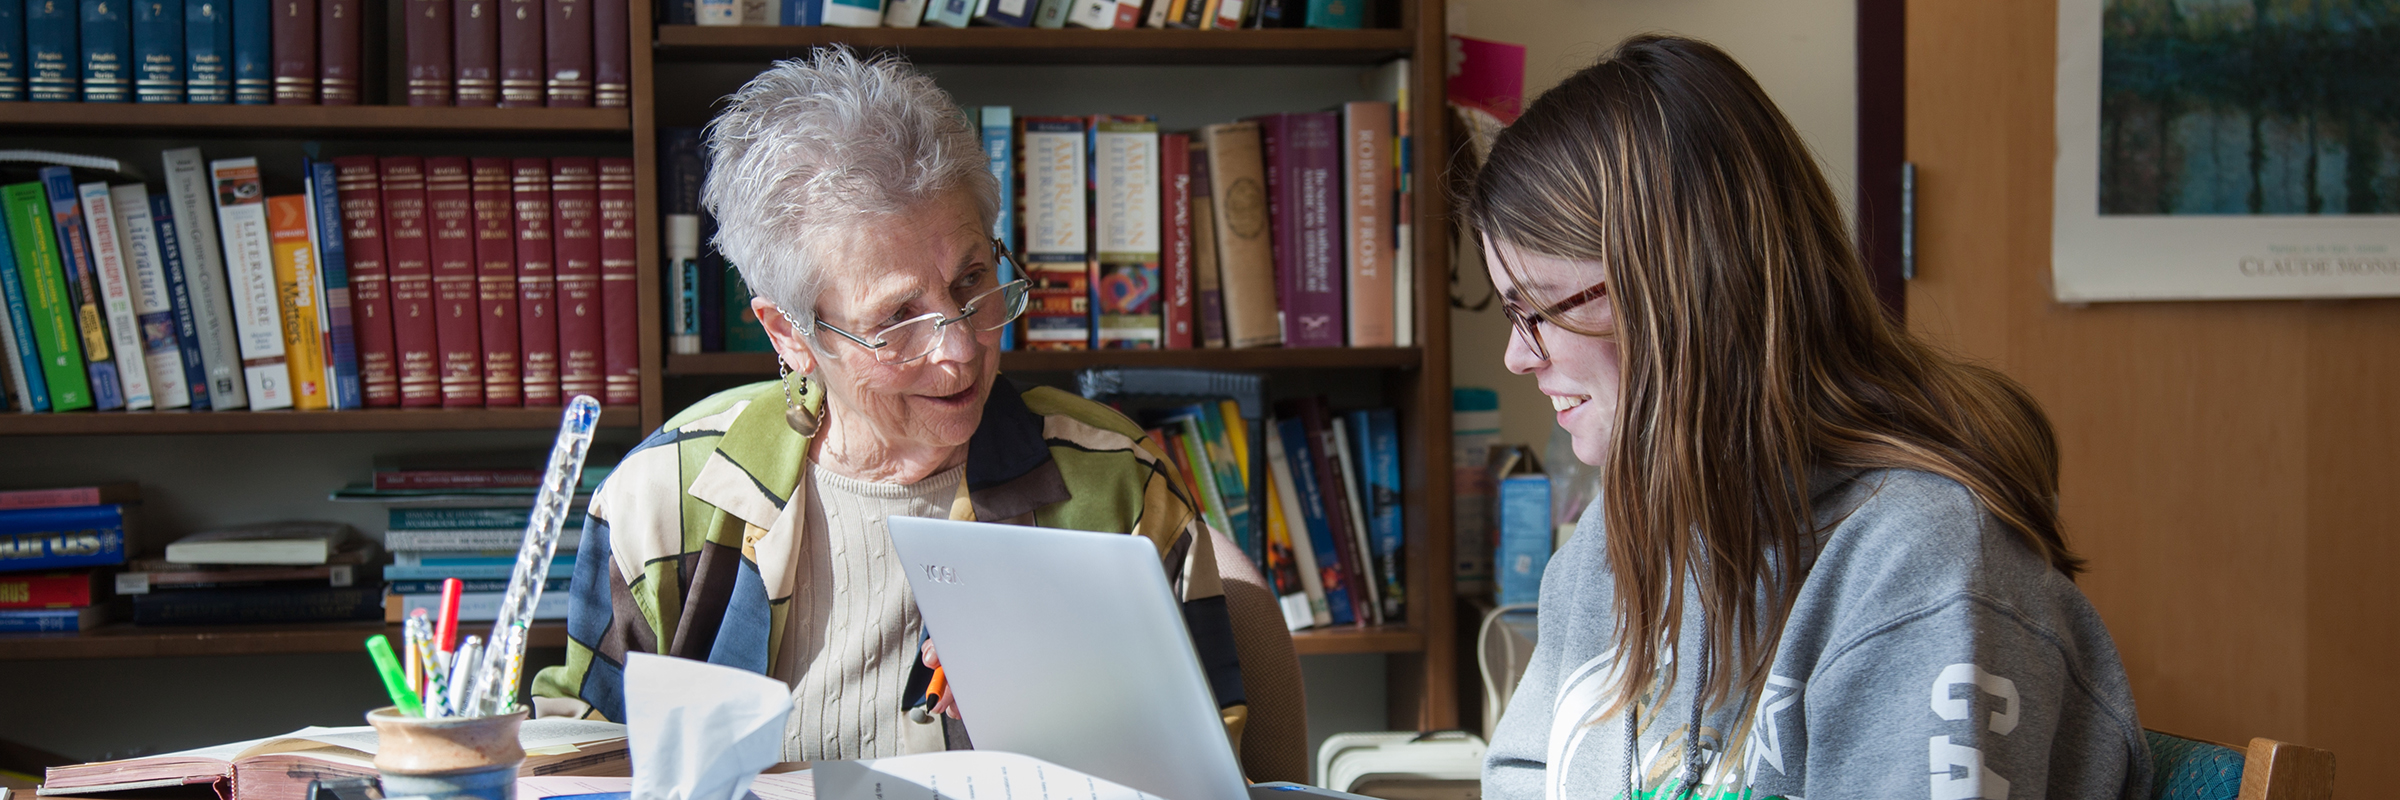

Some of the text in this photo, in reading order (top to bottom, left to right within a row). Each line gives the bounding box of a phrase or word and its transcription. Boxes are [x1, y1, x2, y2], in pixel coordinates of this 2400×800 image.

[45, 2, 54, 13] 5
[98, 3, 108, 14] 6
[153, 4, 162, 16] 7
[203, 4, 212, 17] 8
[289, 3, 297, 16] 1
[334, 5, 343, 17] 2
[426, 5, 435, 17] 4
[471, 4, 481, 17] 5
[516, 7, 527, 19] 6
[563, 6, 572, 19] 7
[990, 139, 1006, 158] The
[1038, 137, 1054, 247] LITERATURE
[1053, 137, 1074, 247] AMERICAN
[1110, 137, 1126, 246] LITERATURE
[1126, 137, 1146, 246] AMERICAN
[321, 169, 340, 249] MLA Handbook
[342, 199, 376, 209] CRITICAL
[388, 199, 425, 209] CRITICAL
[433, 200, 470, 209] CRITICAL
[475, 200, 511, 210] CRITICAL
[516, 200, 550, 211] CRITICAL
[559, 199, 592, 209] CRITICAL
[600, 200, 634, 210] CRITICAL
[1358, 129, 1377, 280] ROBERT FROST
[346, 209, 376, 219] SURVEY
[392, 209, 421, 219] SURVEY
[436, 210, 466, 219] SURVEY
[478, 211, 508, 221] SURVEY
[520, 211, 550, 221] SURVEY
[562, 210, 591, 219] SURVEY
[603, 210, 634, 220] SURVEY
[355, 219, 366, 228] OF
[401, 219, 412, 228] OF
[446, 219, 457, 228] OF
[488, 220, 499, 229] OF
[529, 220, 541, 229] OF
[571, 219, 583, 228] OF
[613, 220, 624, 228] OF
[349, 229, 377, 238] DRAMA
[394, 229, 423, 238] DRAMA
[439, 229, 467, 239] DRAMA
[480, 230, 508, 240] DRAMA
[521, 230, 549, 240] DRAMA
[564, 229, 591, 238] DRAMA
[604, 229, 633, 239] DRAMA
[162, 222, 179, 259] RULES
[126, 212, 162, 308] Literature
[2239, 254, 2335, 278] CLAUDE
[168, 260, 183, 284] FOR
[244, 221, 270, 326] LITERATURE
[293, 248, 312, 306] Writing
[682, 261, 694, 333] GLUE STICK
[173, 285, 194, 338] WRITERS
[282, 280, 302, 345] Matters
[366, 304, 374, 318] 1
[410, 304, 420, 317] 2
[453, 304, 462, 317] 3
[494, 304, 504, 317] 4
[534, 304, 543, 317] 5
[575, 304, 586, 317] 6
[493, 473, 532, 483] Narrative
[920, 564, 964, 586] YOGA
